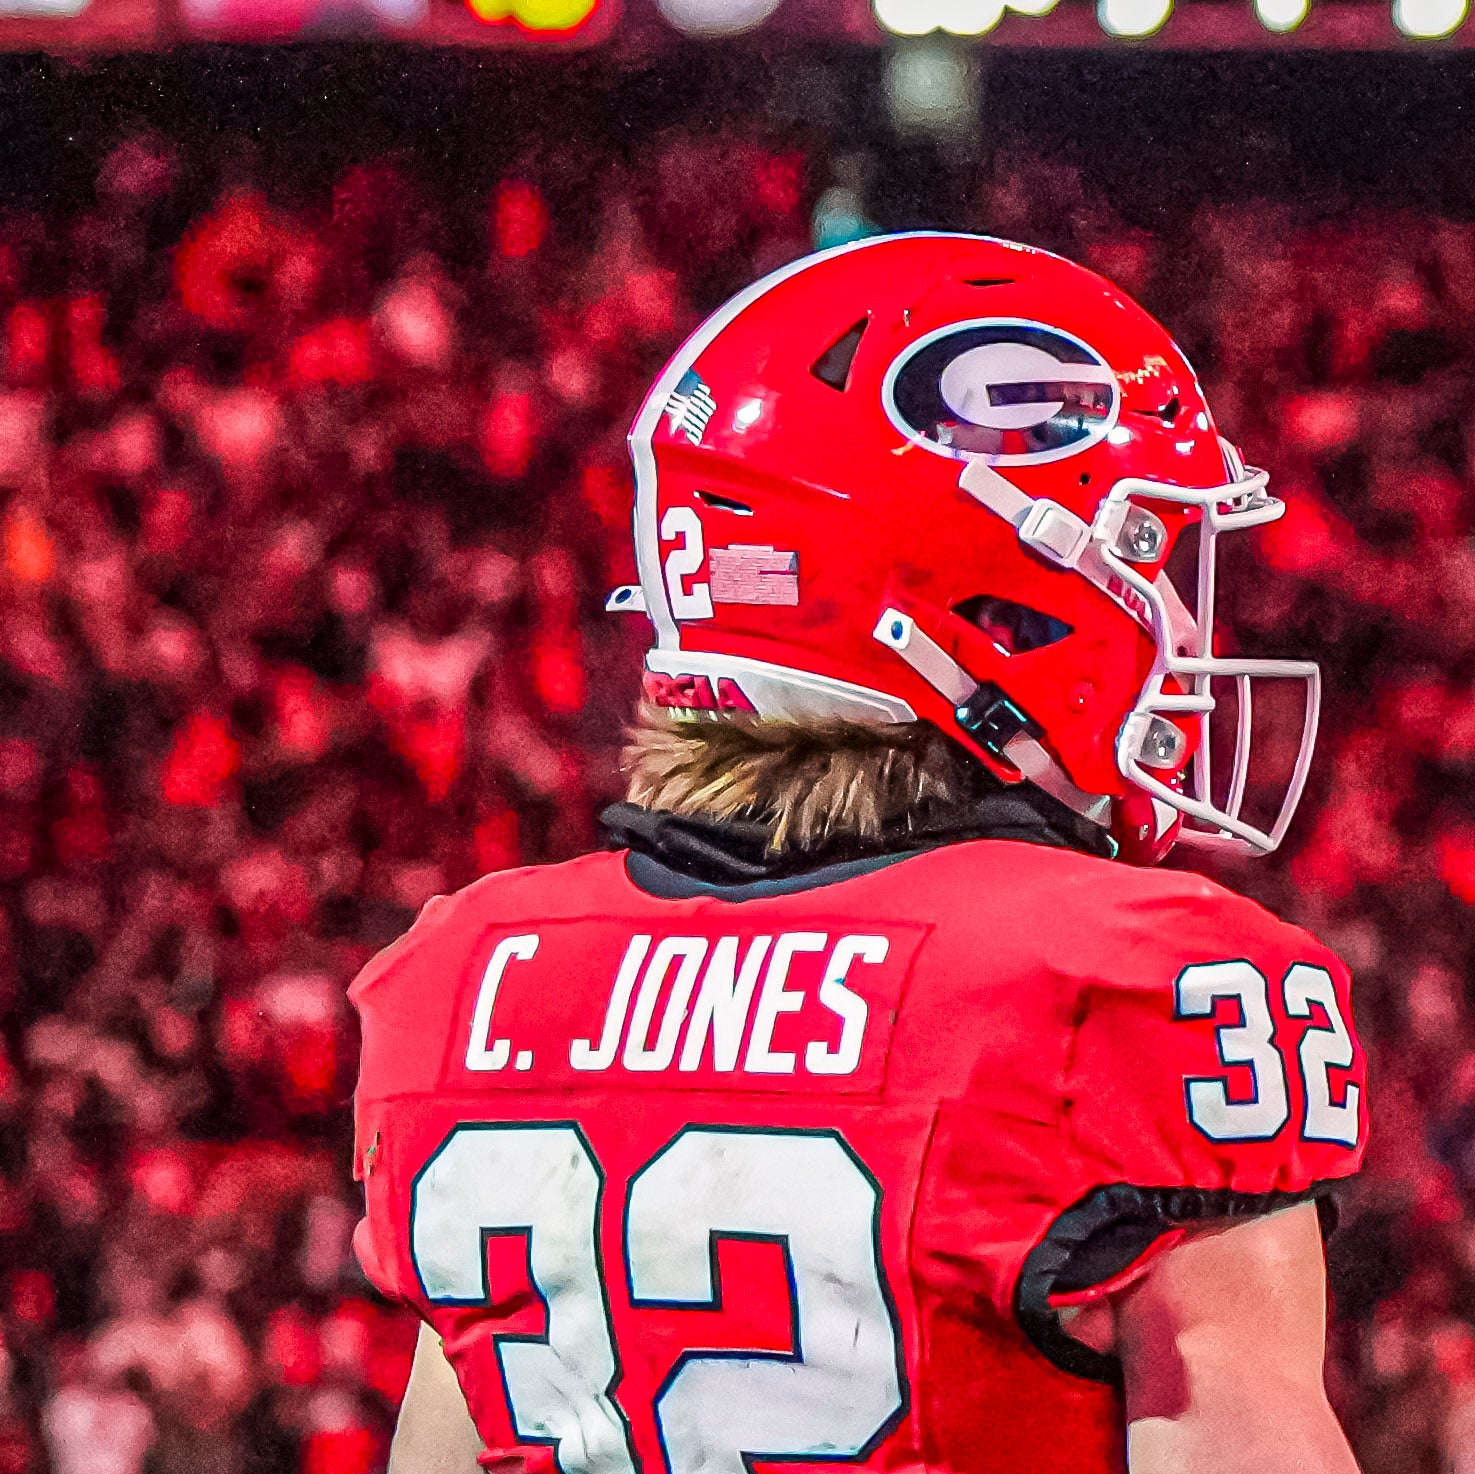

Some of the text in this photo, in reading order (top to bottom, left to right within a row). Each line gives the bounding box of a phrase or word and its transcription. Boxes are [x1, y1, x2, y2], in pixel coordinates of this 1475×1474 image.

[465, 931, 890, 1075] C. JONES
[1174, 958, 1360, 1149] 32
